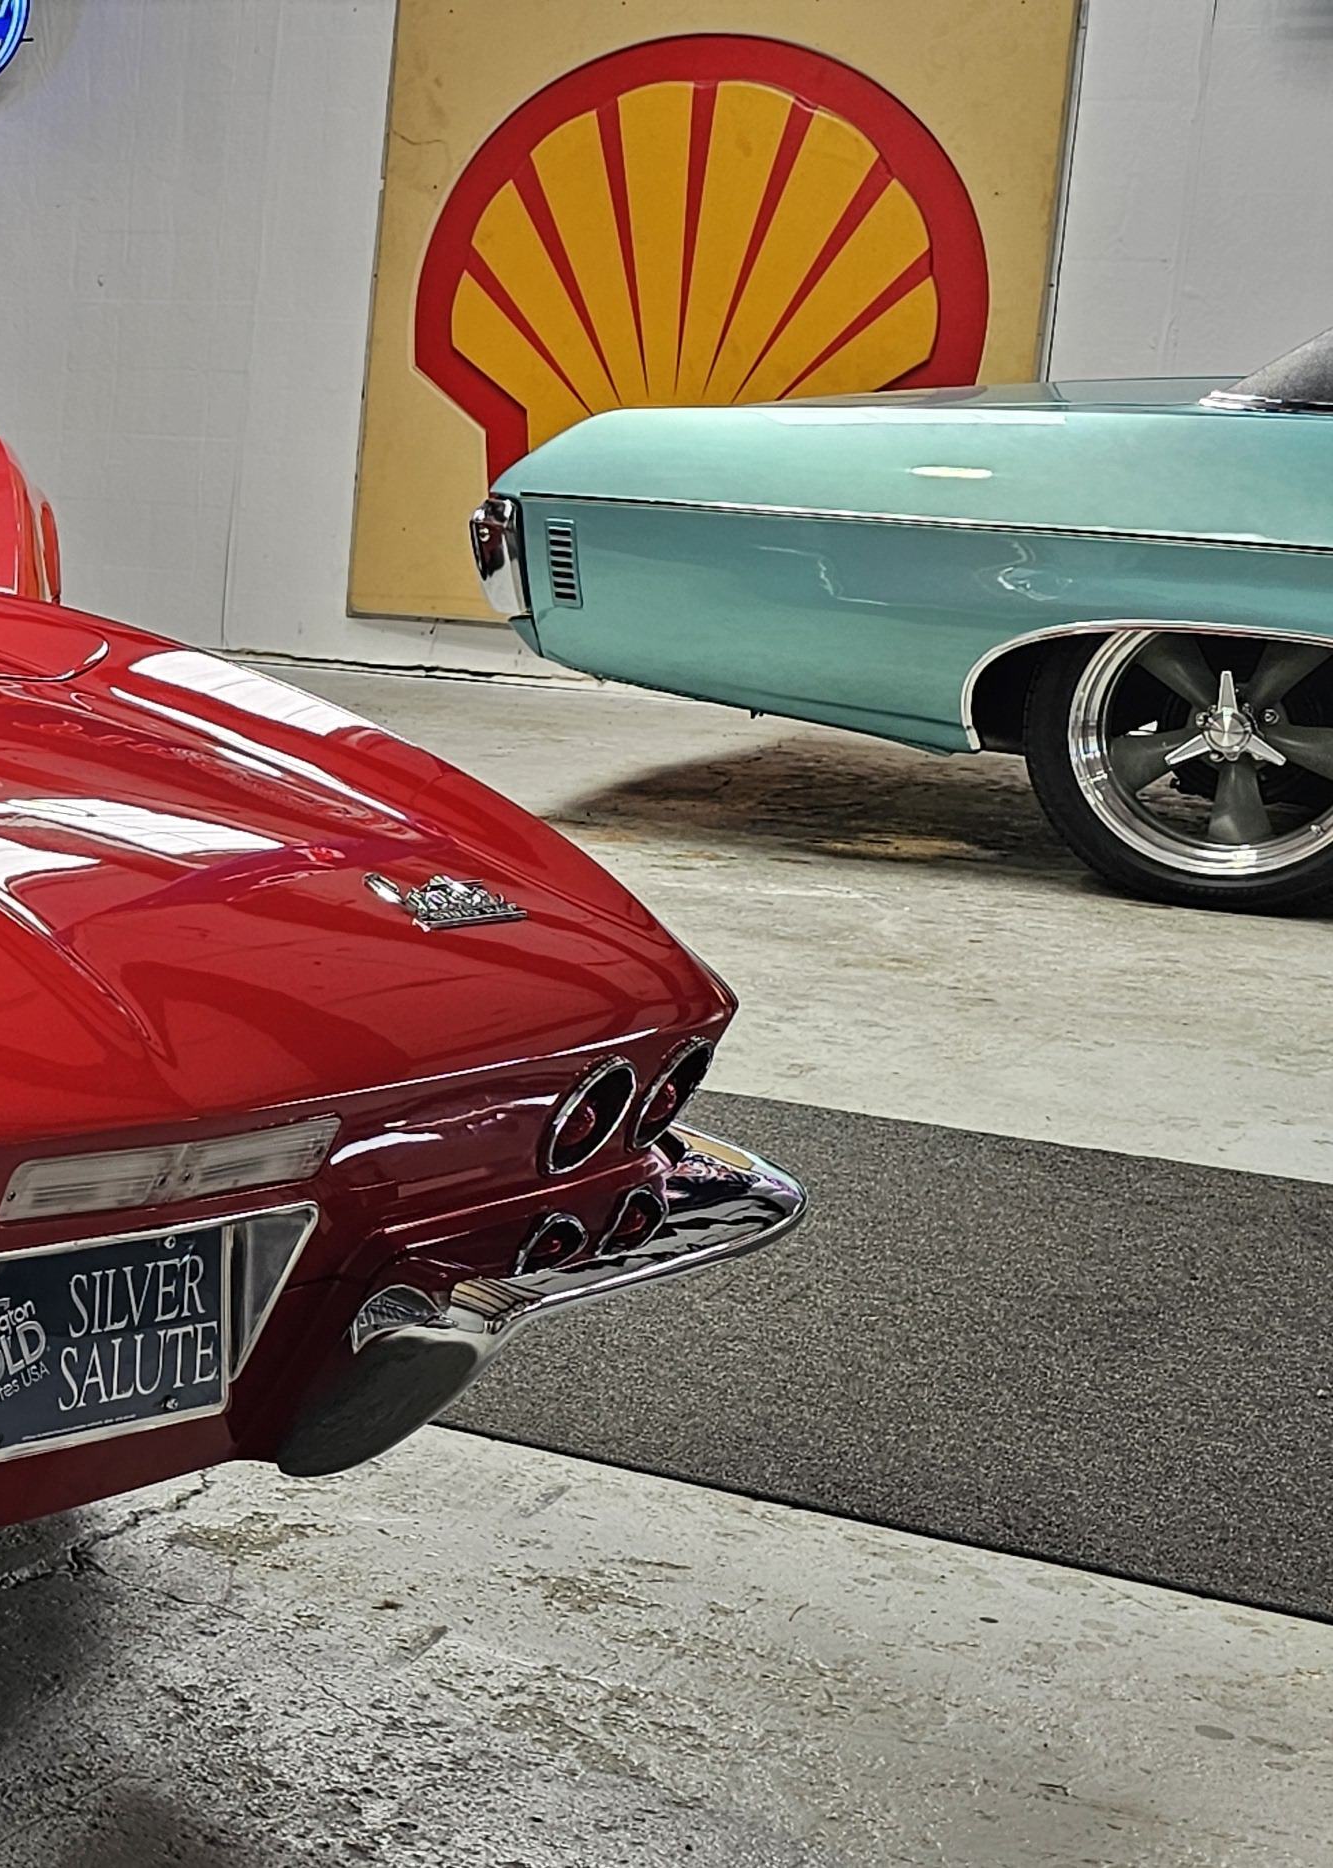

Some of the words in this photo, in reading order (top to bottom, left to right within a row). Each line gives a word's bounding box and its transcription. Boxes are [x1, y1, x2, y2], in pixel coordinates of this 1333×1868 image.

[68, 1254, 206, 1338] SILVER
[20, 1360, 51, 1387] USA
[58, 1321, 218, 1411] SALUTE
